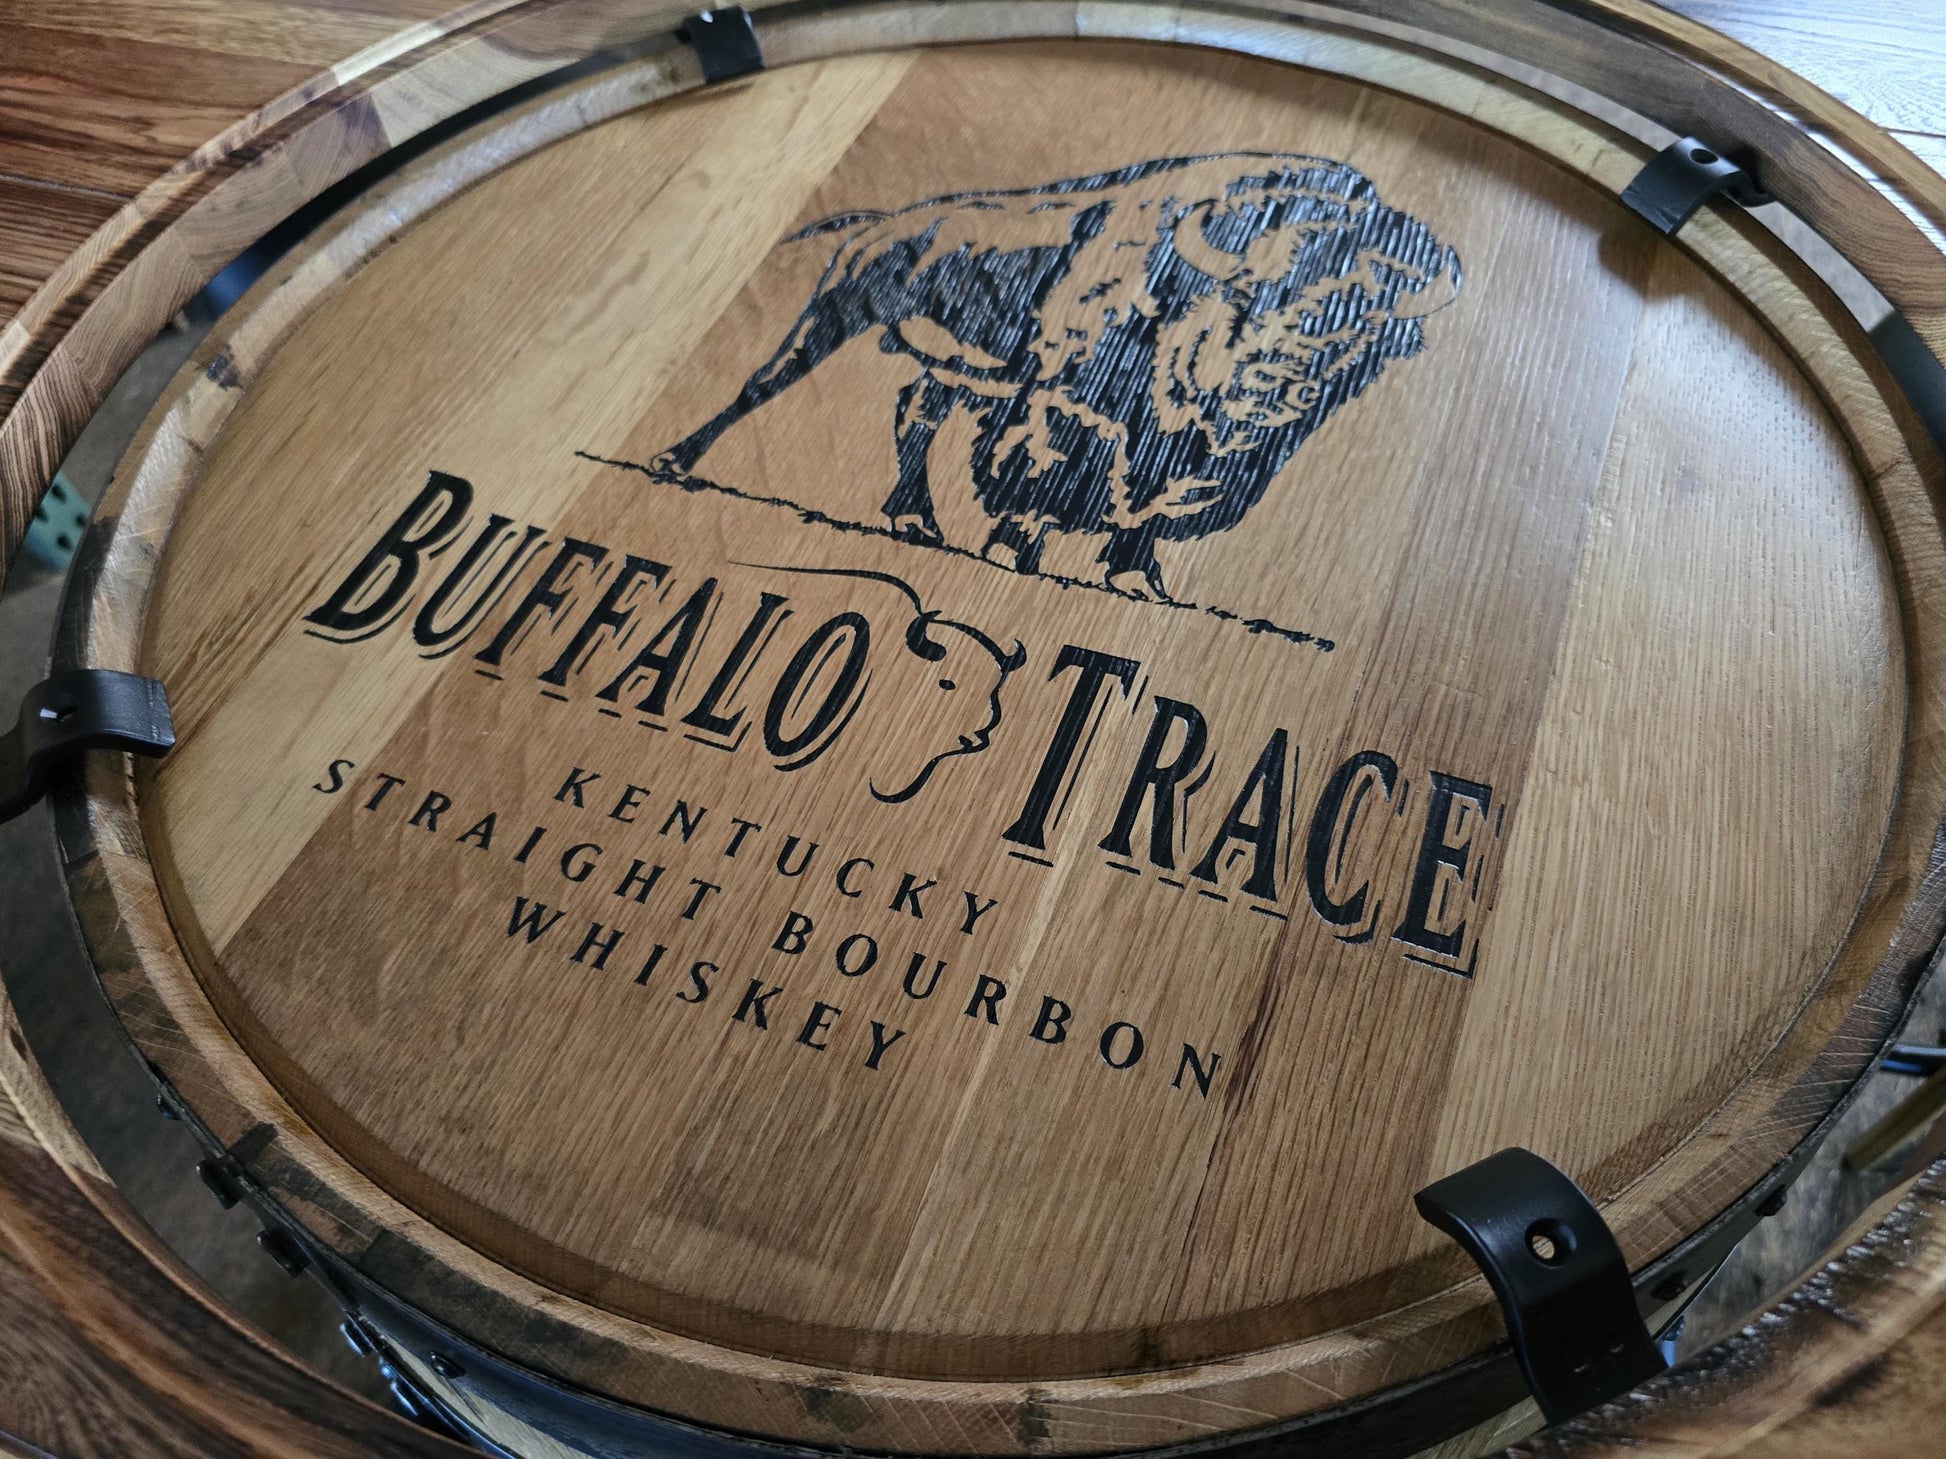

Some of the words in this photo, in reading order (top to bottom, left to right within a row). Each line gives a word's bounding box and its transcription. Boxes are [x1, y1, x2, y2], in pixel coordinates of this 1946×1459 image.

[302, 469, 873, 773] BUFFALO
[1000, 643, 1504, 980] TRACE
[553, 766, 998, 936] KENTUCKY
[311, 758, 721, 921] STRAIGHT
[771, 909, 1223, 1101] BOURBON
[506, 895, 907, 1072] WHISKEY
